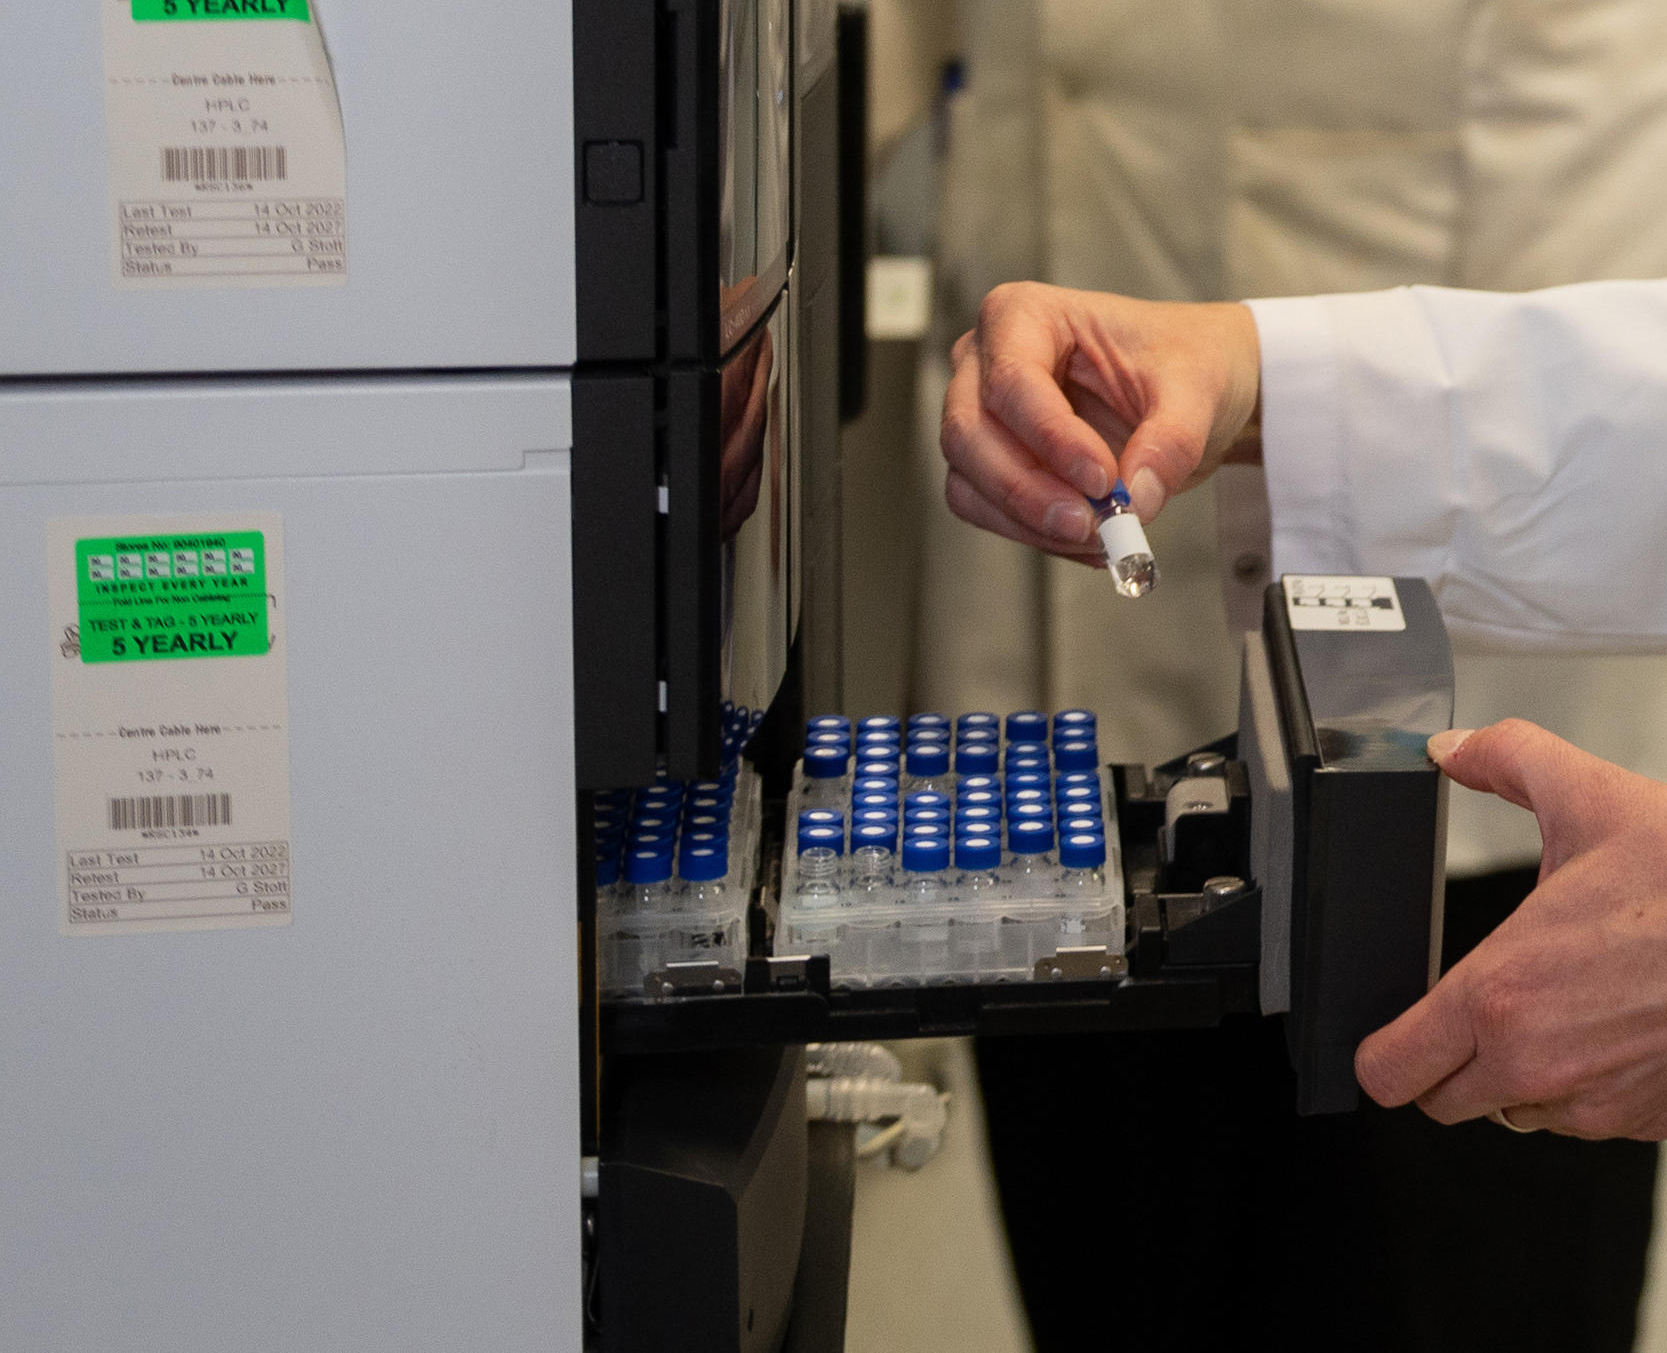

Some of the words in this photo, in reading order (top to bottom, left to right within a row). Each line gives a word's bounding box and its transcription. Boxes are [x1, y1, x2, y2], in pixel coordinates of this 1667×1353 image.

[171, 72, 209, 86] Centre
[212, 72, 246, 86] Cable
[248, 72, 277, 86] Here
[204, 98, 251, 113] HPLC
[190, 119, 217, 134] 137
[122, 204, 156, 219] Last
[161, 203, 193, 218] Test
[254, 203, 270, 217] 14
[274, 202, 301, 216] Oct
[306, 201, 343, 217] 2022
[123, 223, 173, 237] Retest
[254, 221, 271, 235] 14
[274, 221, 302, 235] Oct
[306, 220, 343, 236] 2027
[179, 240, 199, 257] By
[124, 259, 172, 274] Status
[306, 256, 343, 271] Pass
[95, 581, 155, 595] INSPECT
[162, 579, 206, 592] EVERY
[213, 577, 249, 590] YEAR
[88, 618, 128, 633] TEST
[131, 617, 143, 631] &
[146, 616, 176, 630] TAG
[188, 614, 198, 628] 5
[199, 610, 259, 627] YEARLY
[111, 635, 127, 657] 5
[132, 629, 239, 657] YEARLY
[117, 725, 156, 740] Centre
[159, 724, 191, 738] Cable
[195, 722, 222, 736] Here
[151, 747, 197, 763] HPLC
[137, 768, 163, 783] 137
[70, 853, 104, 868] Last
[108, 851, 140, 866] Test
[200, 848, 216, 862] 14
[219, 846, 247, 861] Oct
[250, 844, 287, 860] 2022
[70, 870, 121, 886] Retest
[200, 865, 216, 879] 14
[220, 864, 247, 878] Oct
[250, 862, 287, 878] 2027
[72, 888, 122, 904] Tested
[126, 886, 146, 903] By
[71, 906, 118, 921] Status
[251, 897, 288, 912] Pass
